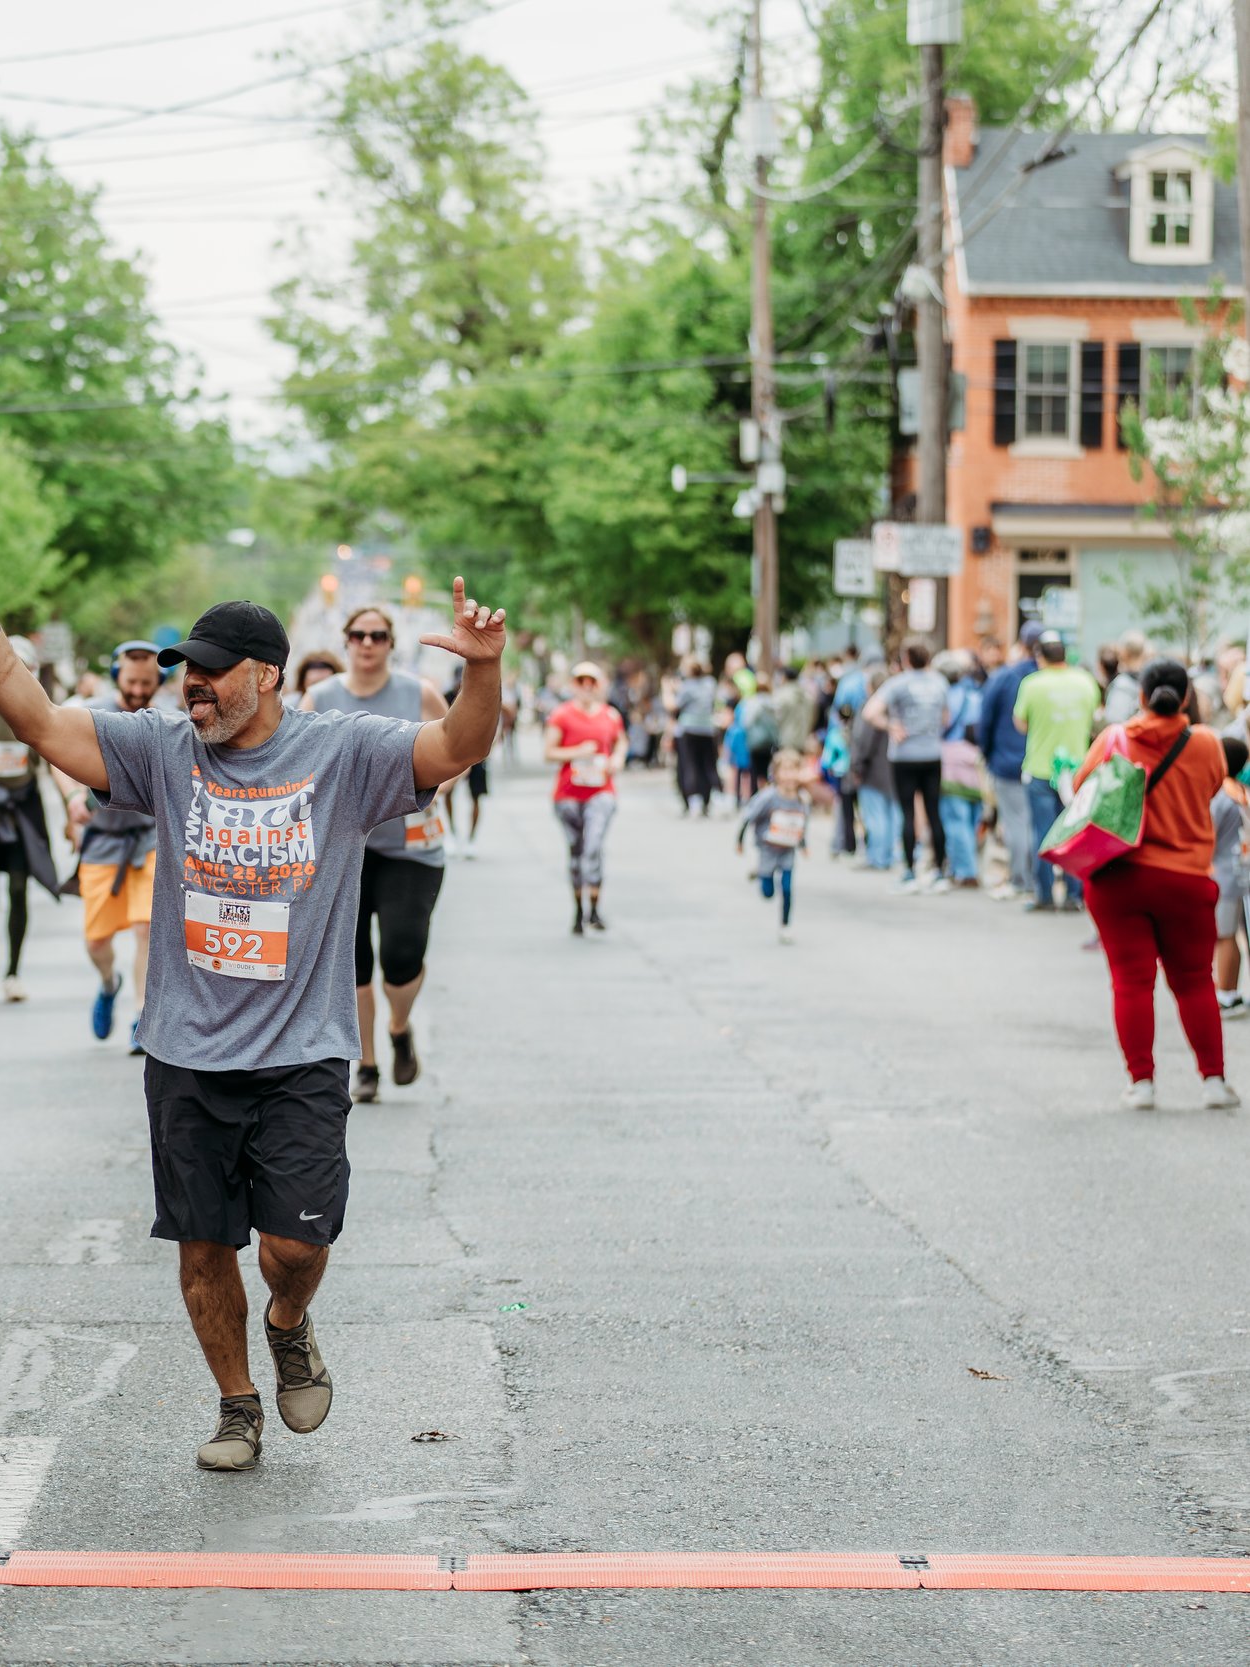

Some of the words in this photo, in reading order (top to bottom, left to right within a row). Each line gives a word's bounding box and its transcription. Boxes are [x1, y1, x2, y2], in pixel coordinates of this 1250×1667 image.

[207, 781, 246, 799] Years
[184, 780, 204, 855] ywca
[202, 791, 314, 829] race
[205, 821, 308, 848] against
[199, 838, 316, 868] RACISM
[184, 855, 229, 878] APRIL
[232, 865, 263, 883] 25,
[268, 860, 316, 880] 2026
[184, 868, 286, 896] LANCASTER,
[293, 877, 313, 893] PA
[204, 928, 263, 960] 592
